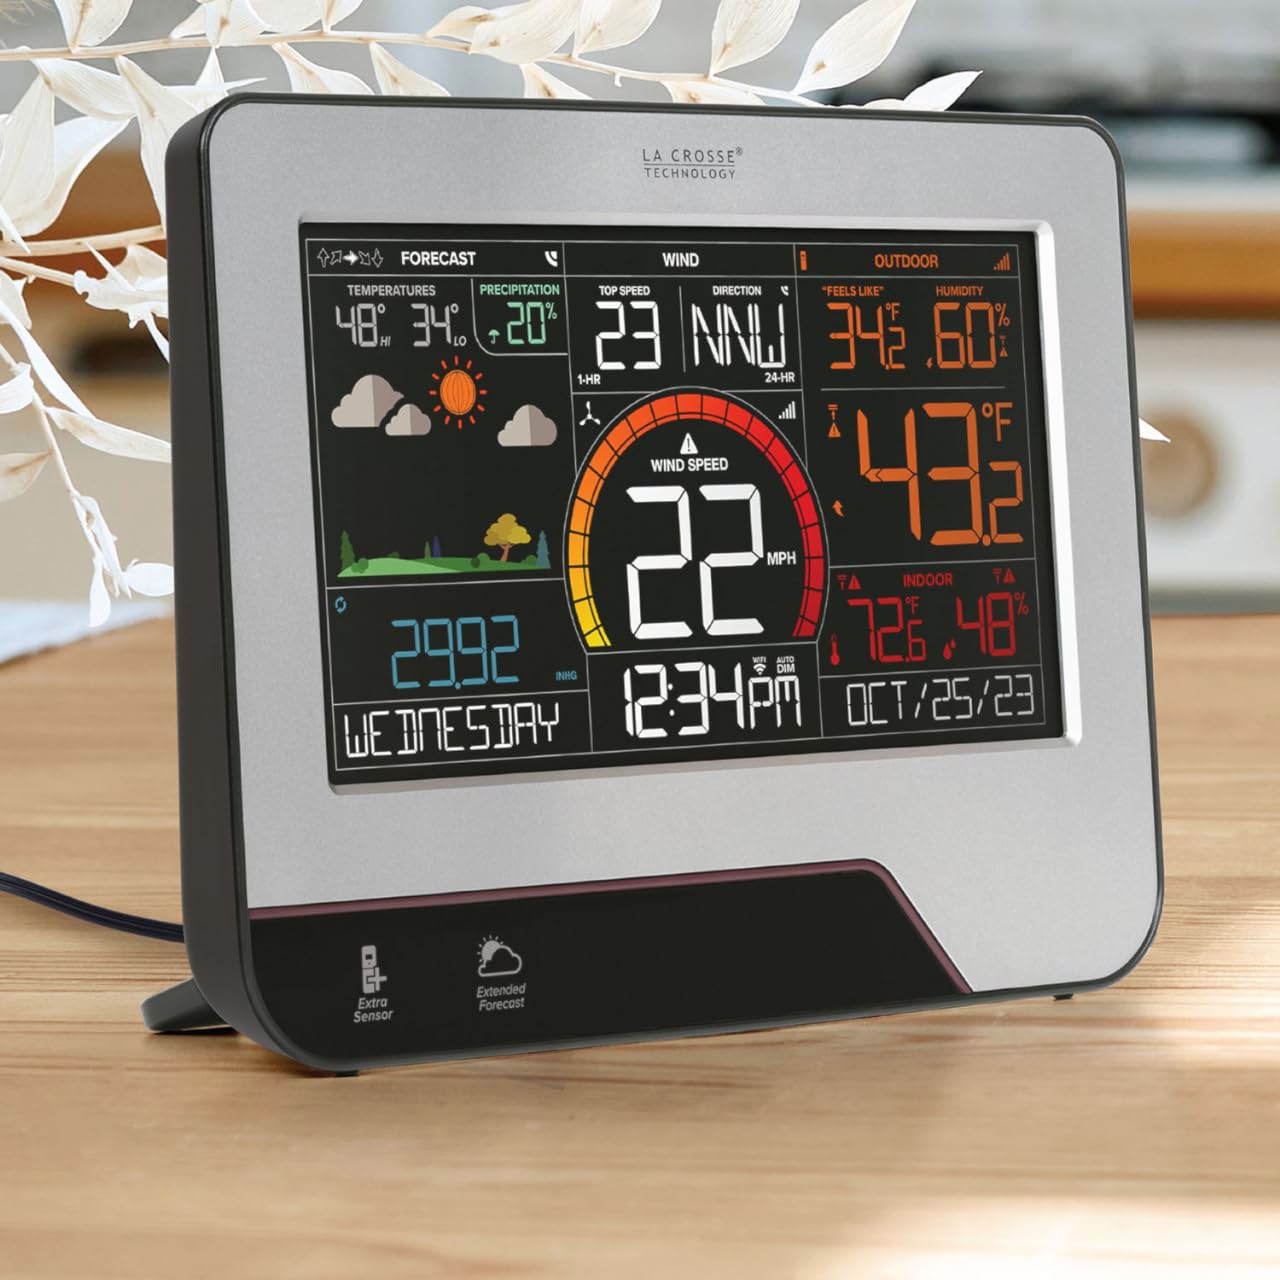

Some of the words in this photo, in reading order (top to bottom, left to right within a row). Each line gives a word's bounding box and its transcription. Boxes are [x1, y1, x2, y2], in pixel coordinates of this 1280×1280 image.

[642, 148, 662, 162] LA
[644, 167, 735, 179] TECHNOLOGY
[401, 251, 476, 266] FORECAST
[662, 253, 700, 267] WIND
[874, 254, 939, 268] OUTDOOR
[347, 285, 436, 296] TEMPERATURES
[479, 284, 560, 295] PRECIPITATION
[599, 286, 619, 296] TOP
[619, 286, 651, 296] SPEED
[712, 286, 762, 296] DIRECTION
[936, 286, 984, 296] HUMIDITY
[380, 336, 391, 347] HI
[453, 336, 467, 347] LO
[595, 300, 662, 370] 23
[691, 303, 786, 368] NNW
[577, 373, 601, 385] 1-HR
[764, 372, 796, 383] 24-HR
[651, 459, 685, 472] WIND
[687, 457, 729, 471] SPEED
[626, 484, 765, 640] 22
[767, 552, 796, 565] MPH
[903, 573, 953, 587] INDOOR
[777, 664, 796, 673] DIM
[555, 672, 578, 681] INHG
[623, 662, 745, 738] 12:34
[846, 674, 1035, 726] OCT/25/23
[344, 702, 560, 758] WEDNESDAY
[476, 983, 526, 998] Extended
[358, 997, 388, 1010] Extra
[479, 997, 525, 1012] Forecast
[353, 1010, 393, 1023] Sensor
